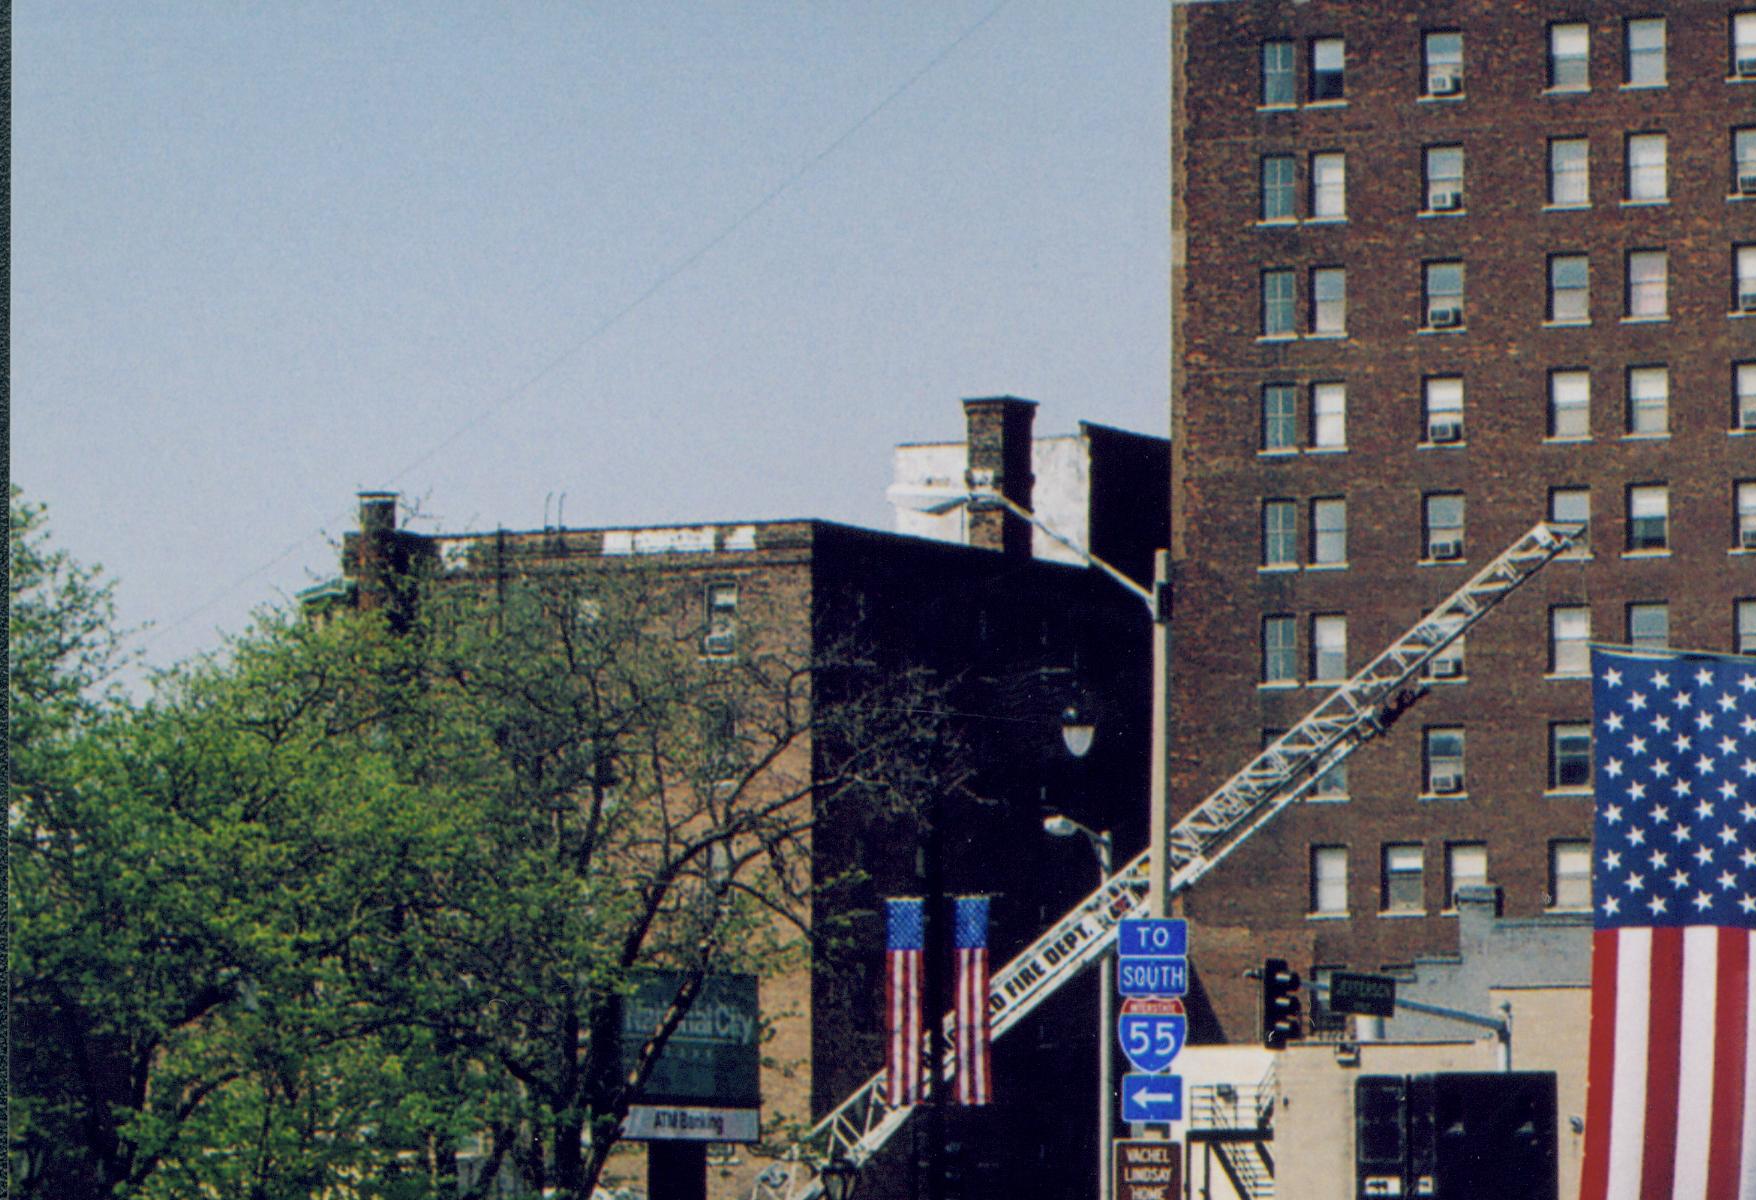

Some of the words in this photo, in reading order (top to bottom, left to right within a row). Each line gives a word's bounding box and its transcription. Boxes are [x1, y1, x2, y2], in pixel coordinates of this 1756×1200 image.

[1137, 927, 1169, 947] TO
[1004, 959, 1046, 998] FIRE
[1042, 923, 1094, 966] DEPT.
[1123, 965, 1184, 987] SOUTH
[1130, 1021, 1176, 1056] 55
[1125, 1147, 1171, 1163] VACHEL
[1124, 1166, 1173, 1182] LINDSAY
